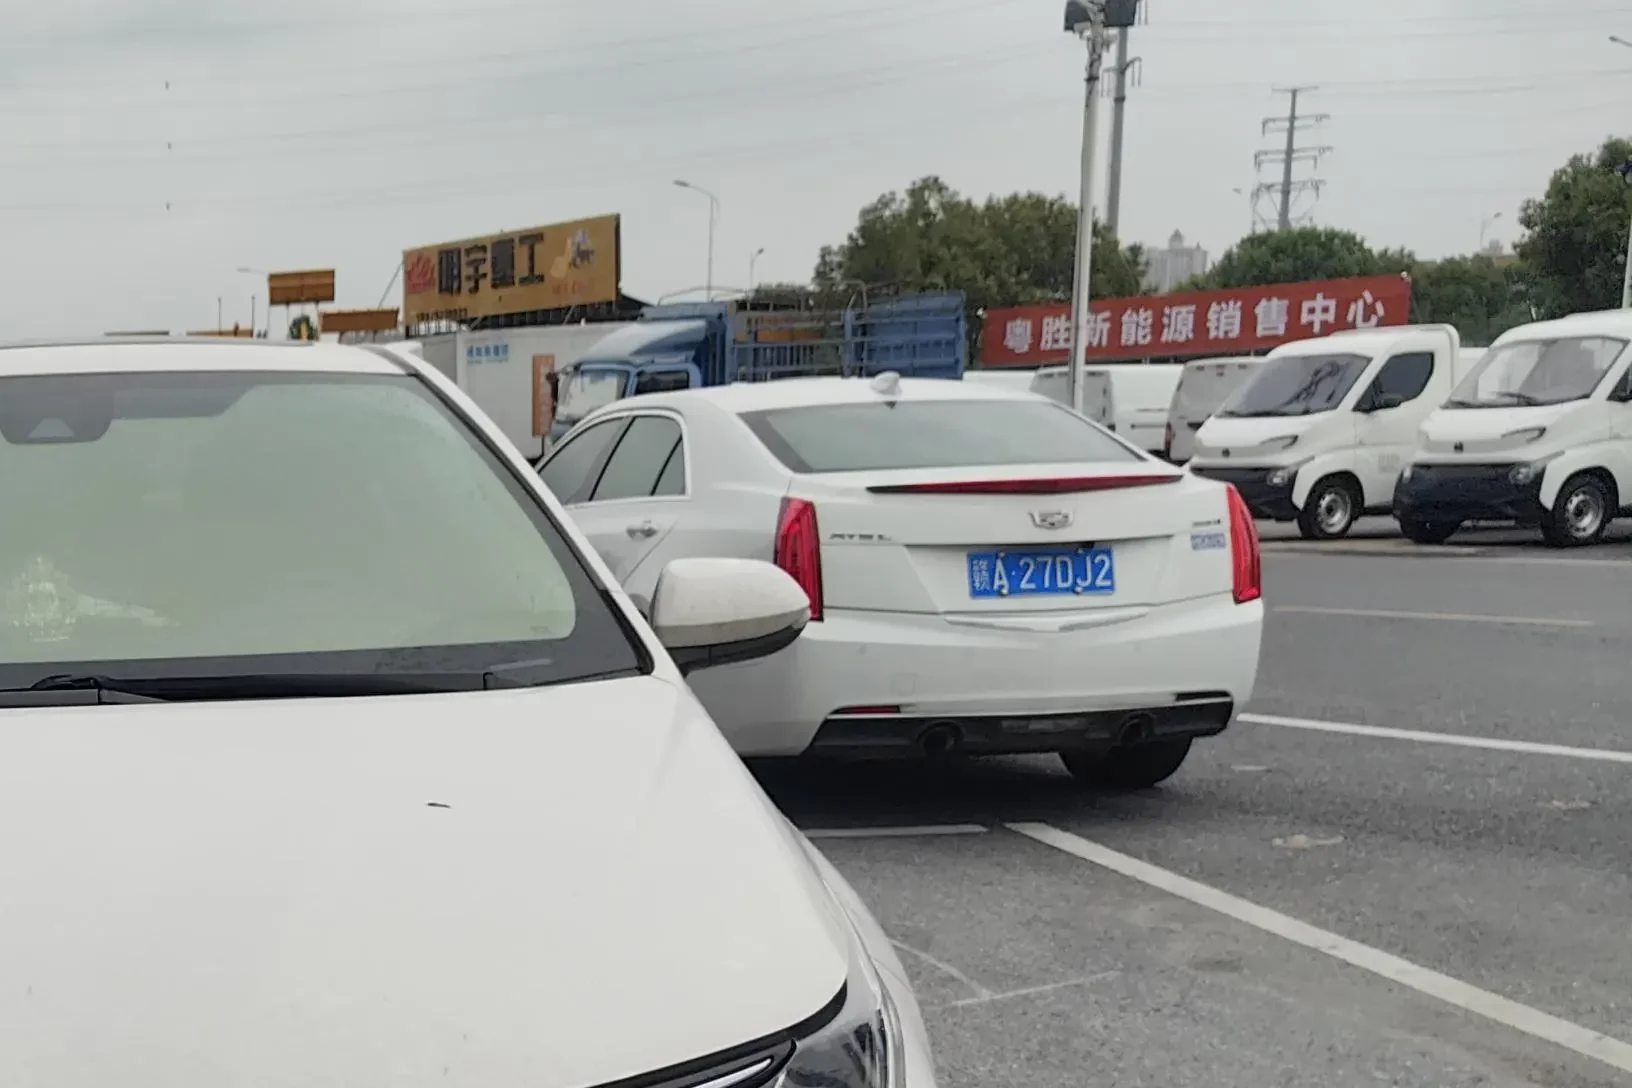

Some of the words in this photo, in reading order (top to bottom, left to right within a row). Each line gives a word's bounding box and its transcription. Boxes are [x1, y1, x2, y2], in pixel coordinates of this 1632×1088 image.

[1003, 290, 1386, 354] 粤胜新能源销售中心
